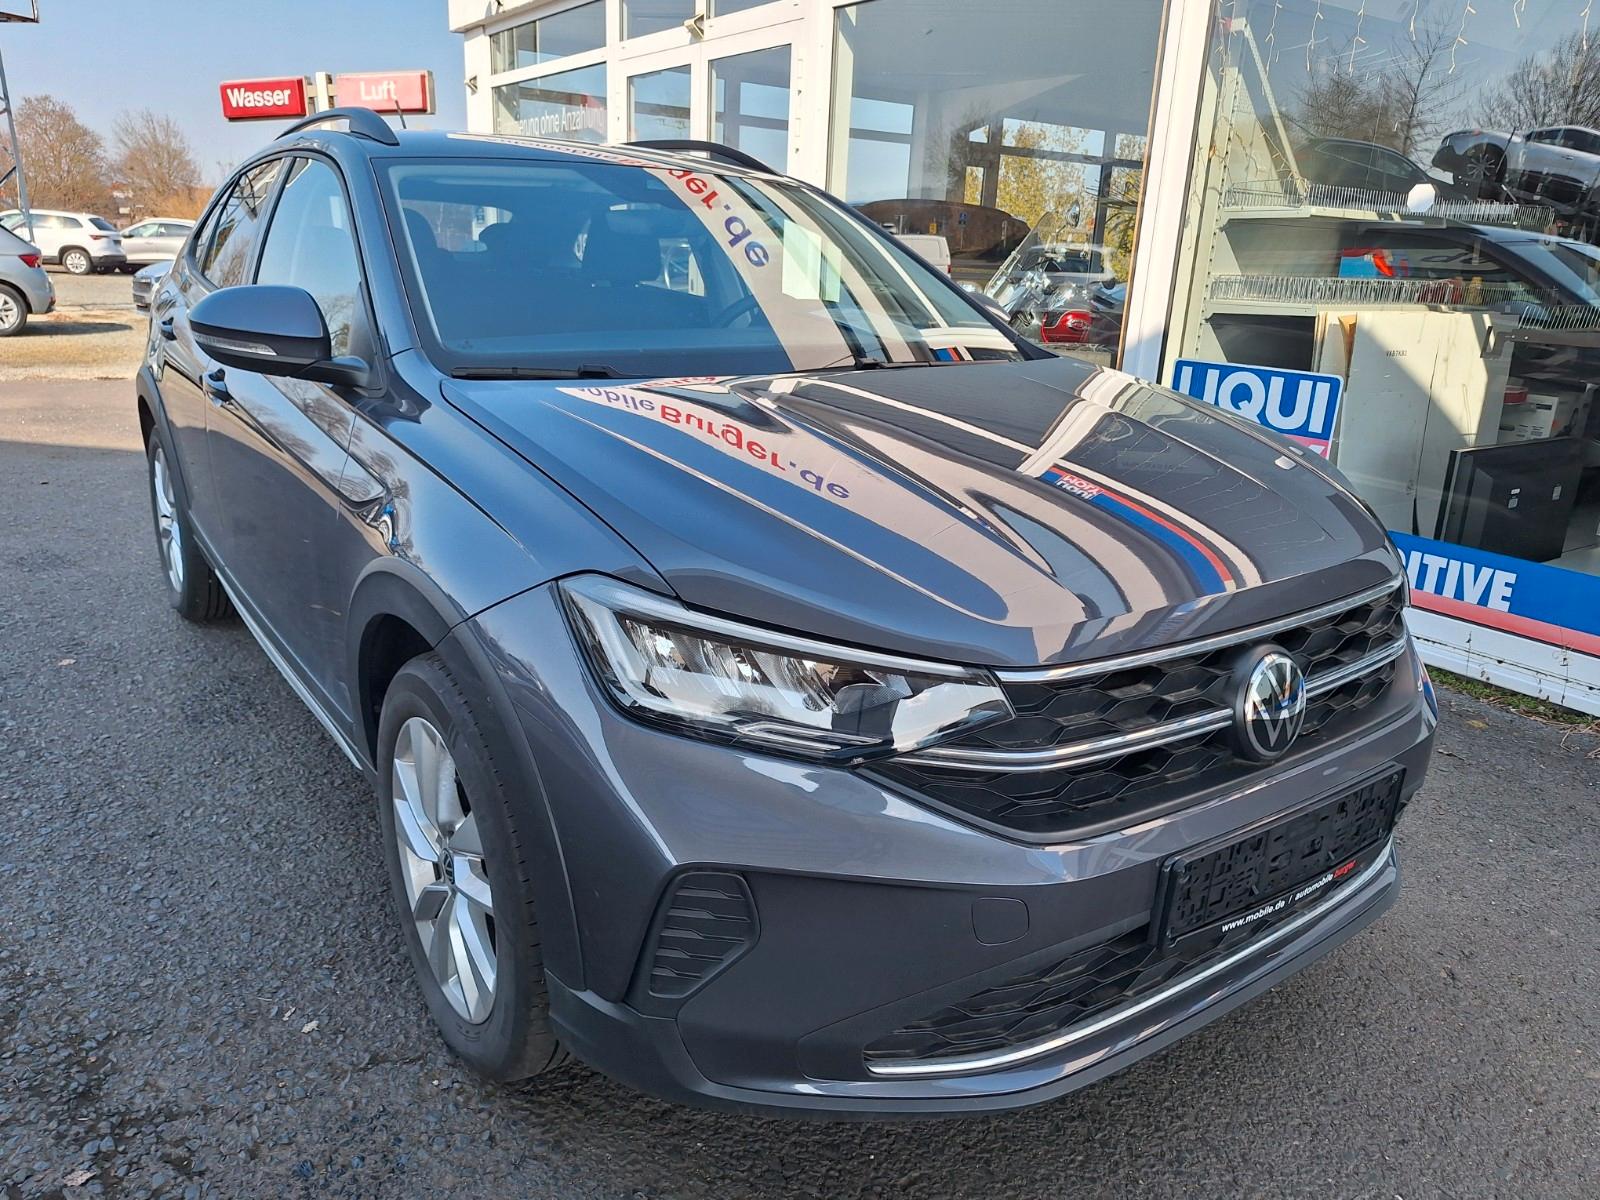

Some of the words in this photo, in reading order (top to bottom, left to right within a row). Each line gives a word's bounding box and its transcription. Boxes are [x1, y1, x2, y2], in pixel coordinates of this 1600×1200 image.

[226, 88, 291, 108] Wasser
[359, 80, 396, 100] Luft
[1221, 899, 1286, 933] www.mobile.de
